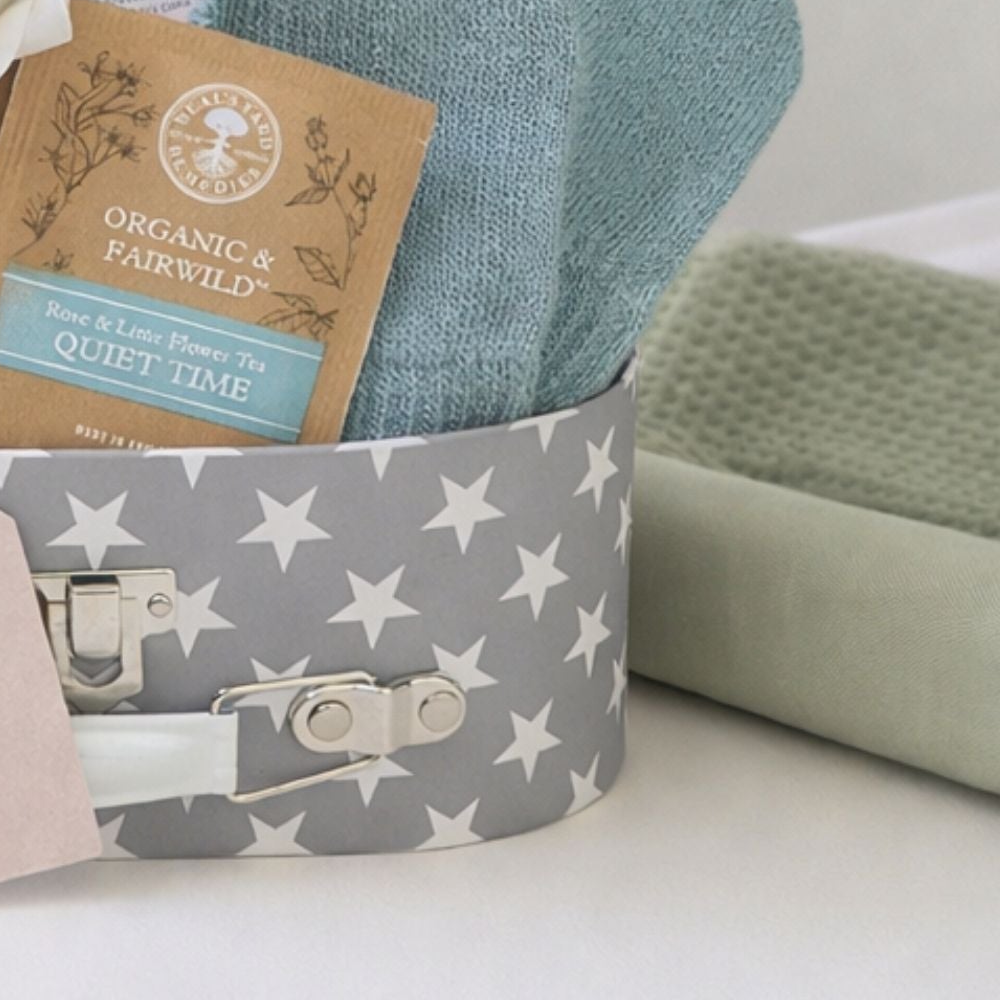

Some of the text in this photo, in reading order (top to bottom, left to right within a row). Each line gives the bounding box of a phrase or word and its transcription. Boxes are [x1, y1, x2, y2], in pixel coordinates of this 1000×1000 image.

[104, 206, 275, 273] ORGANIC &
[54, 331, 251, 402] QUIET TIME
[94, 315, 112, 332] &
[235, 351, 266, 374] Tea
